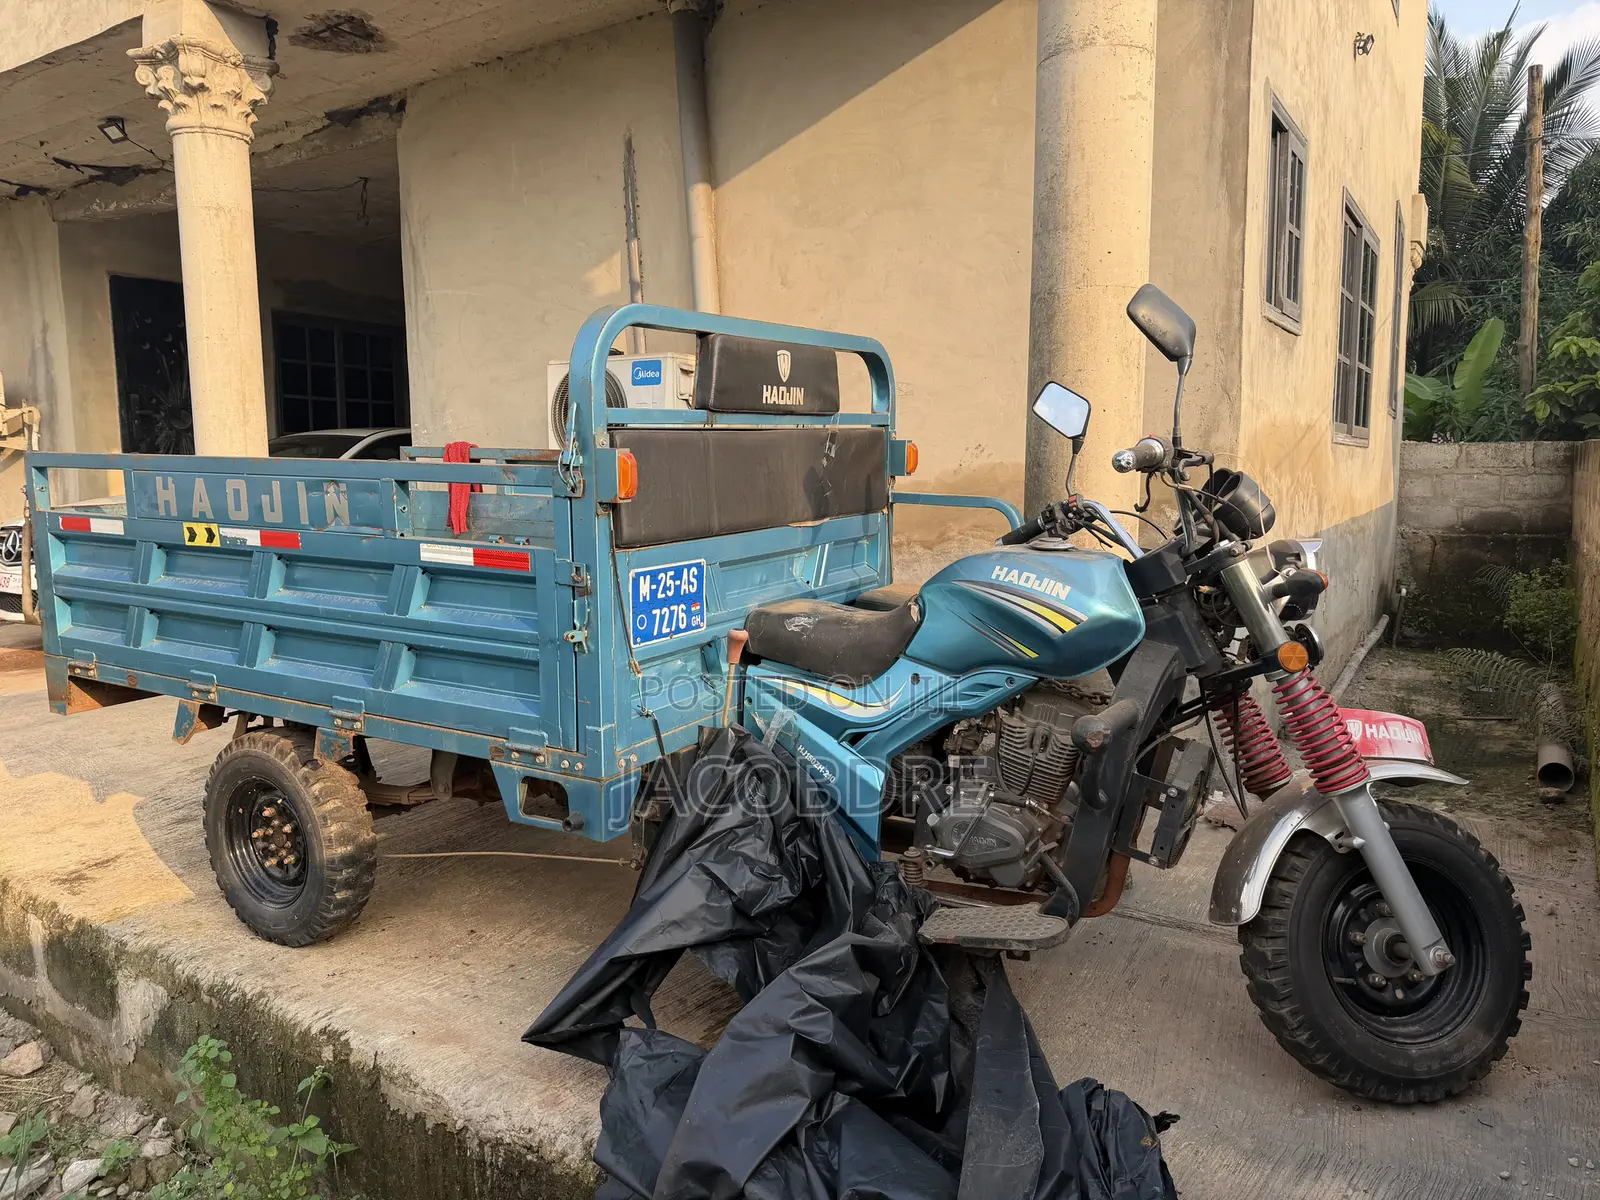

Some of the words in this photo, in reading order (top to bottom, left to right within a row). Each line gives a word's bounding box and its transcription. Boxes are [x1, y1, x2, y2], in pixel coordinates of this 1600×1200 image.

[633, 366, 660, 380] Midea
[762, 384, 805, 406] HAOJIN
[155, 476, 350, 526] HAOJIN
[639, 566, 698, 603] M-25-AS
[990, 565, 1072, 601] HAOJIN
[651, 603, 687, 637] 7276
[691, 614, 701, 628] GH
